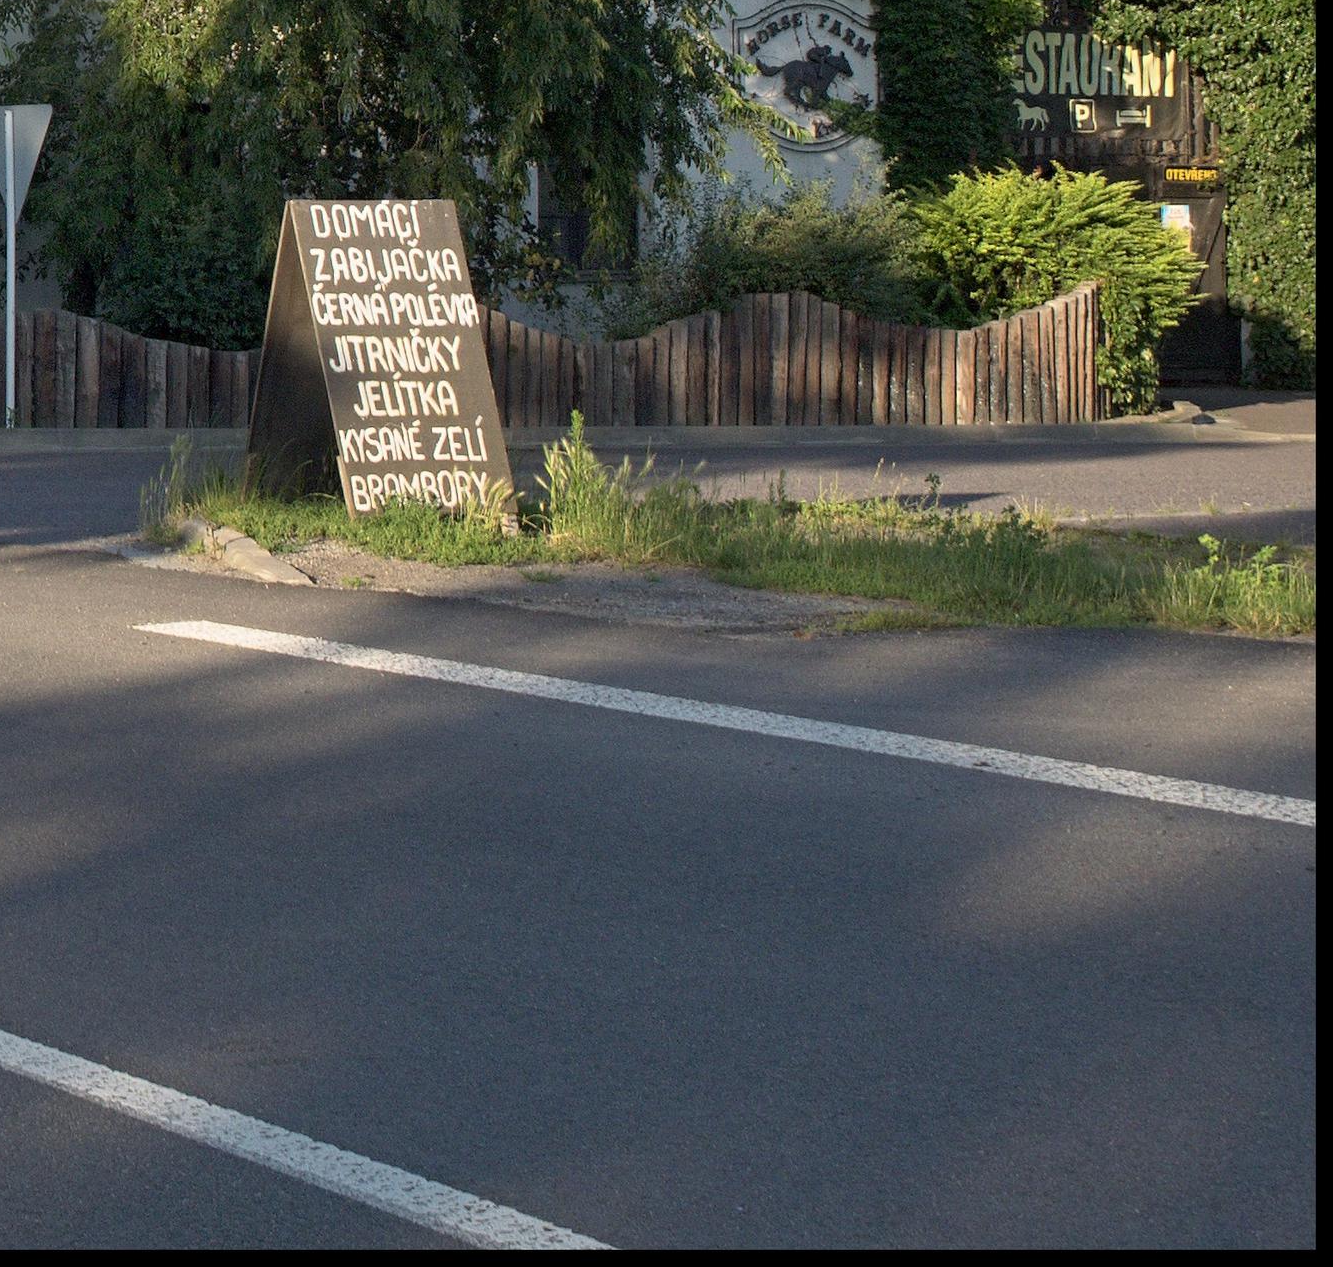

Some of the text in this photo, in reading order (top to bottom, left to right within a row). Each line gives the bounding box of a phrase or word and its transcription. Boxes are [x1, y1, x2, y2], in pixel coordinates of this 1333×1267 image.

[746, 12, 872, 57] HORSE FARM
[1010, 29, 1176, 97] ESTAURANT
[310, 200, 421, 241] DOMÁCÍ
[310, 238, 462, 284] ZABIJAČKA
[312, 283, 480, 328] ČERNÁ POLÉVKA
[329, 328, 460, 373] JITRNIČKY
[353, 371, 460, 418] JELÍTKA
[338, 415, 488, 464] KYSANÉ ZELÍ
